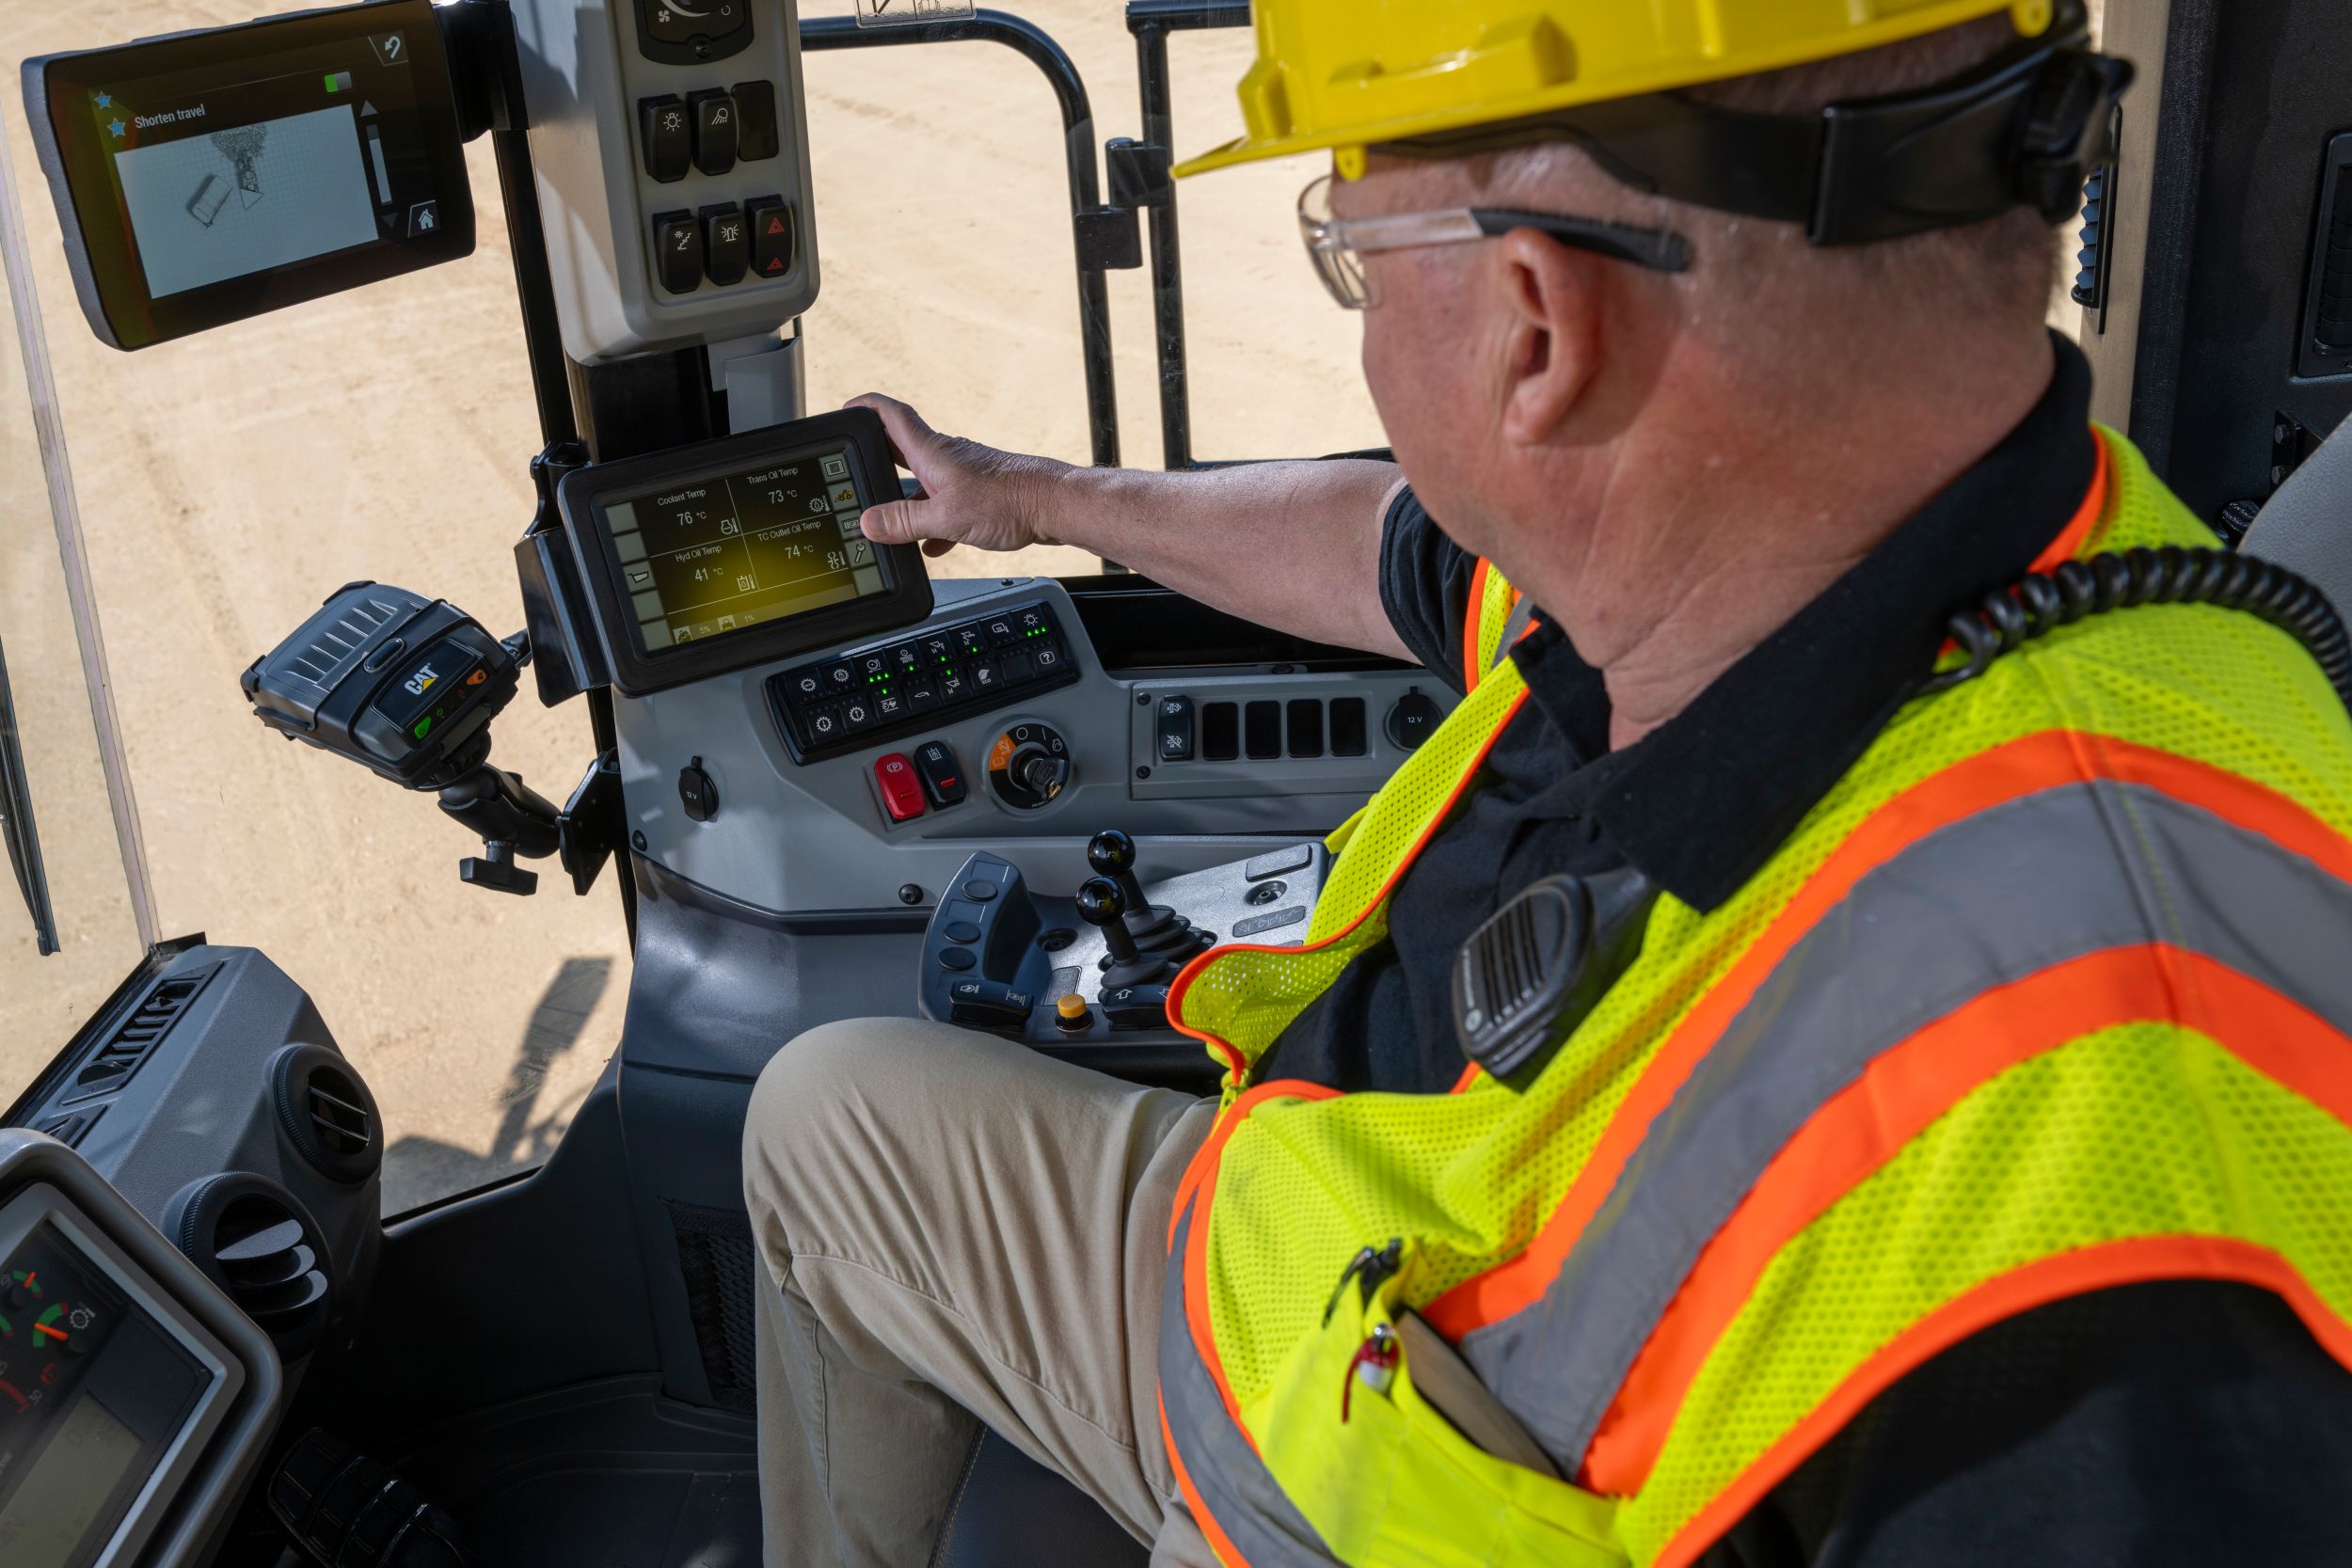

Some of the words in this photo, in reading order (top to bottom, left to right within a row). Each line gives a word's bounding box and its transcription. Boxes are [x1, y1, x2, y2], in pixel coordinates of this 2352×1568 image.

[135, 113, 176, 128] Shorten
[177, 103, 206, 119] travel
[747, 474, 768, 484] Trans
[768, 470, 779, 480] Oil
[778, 467, 799, 476] Temp
[658, 493, 686, 506] Coolant
[685, 489, 707, 499] Temp
[768, 489, 785, 504] 73
[787, 489, 798, 498] °C
[676, 511, 693, 526] 76
[696, 511, 707, 519] °C
[756, 533, 770, 542] TC
[770, 528, 791, 539] Outlet
[791, 524, 802, 533] Oil
[801, 521, 821, 530] Temp
[675, 551, 691, 562] Hyd
[691, 548, 701, 558] Oil
[701, 546, 723, 555] Temp
[785, 544, 801, 560] 74
[694, 567, 708, 581] 41
[405, 664, 439, 695] CAT
